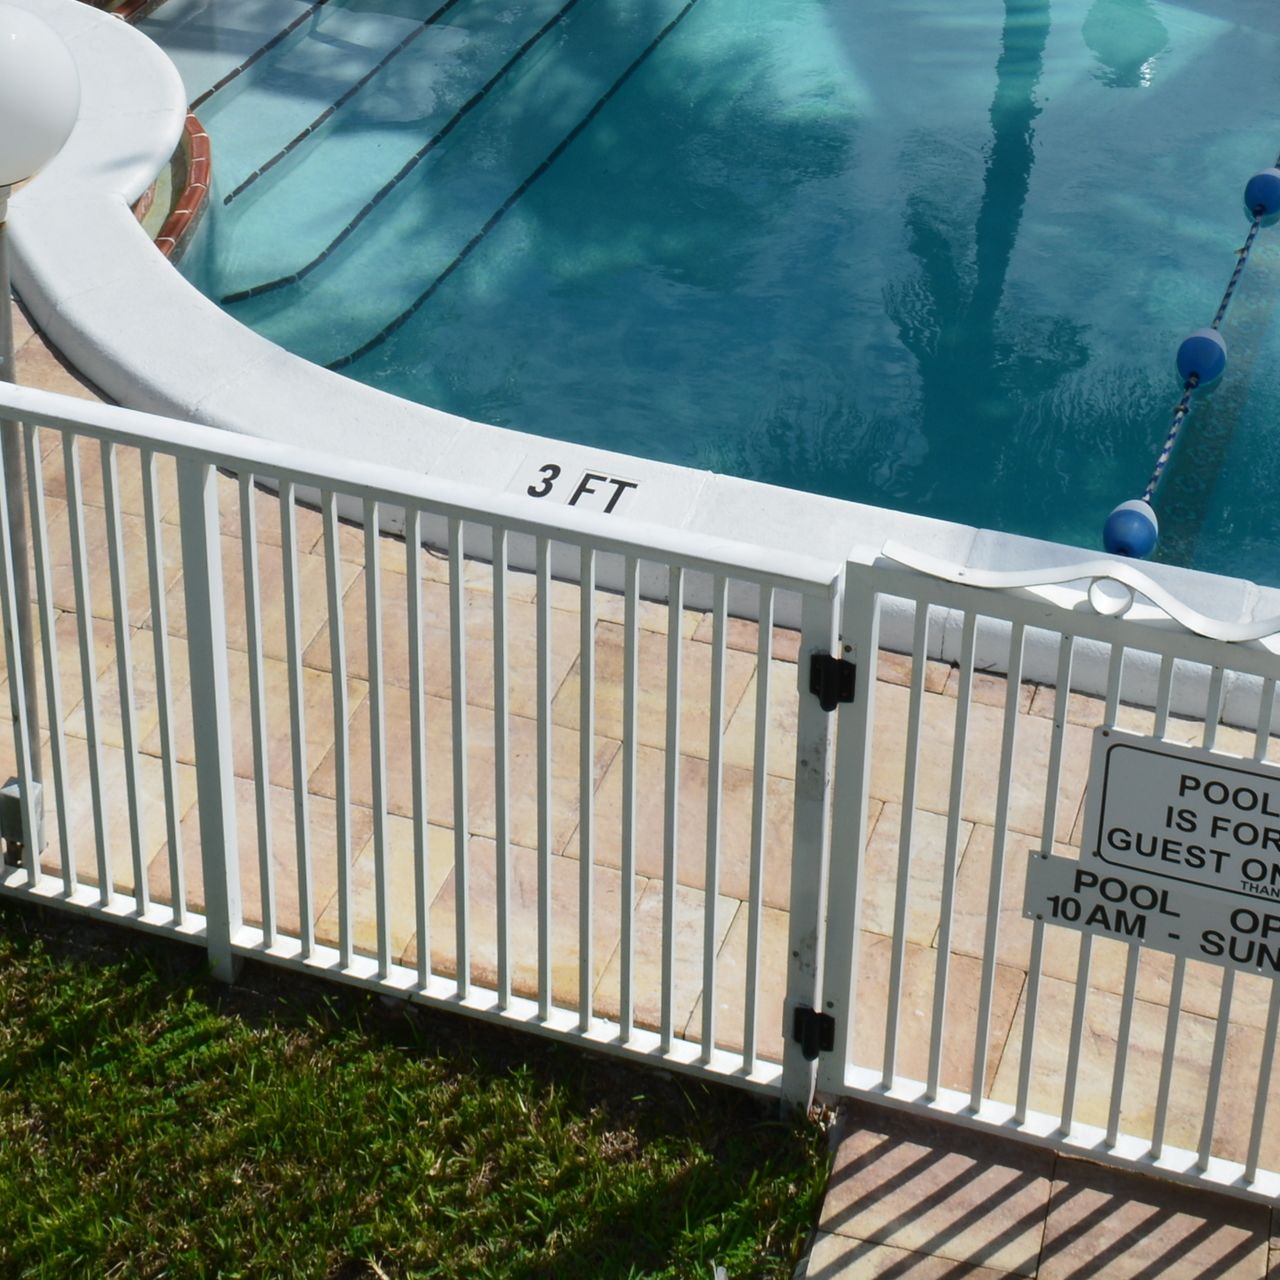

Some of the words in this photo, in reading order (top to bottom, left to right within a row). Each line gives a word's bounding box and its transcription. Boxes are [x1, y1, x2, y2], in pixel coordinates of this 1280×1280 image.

[527, 463, 562, 498] 3
[568, 473, 638, 514] FT
[1166, 805, 1197, 833] IS
[1179, 774, 1280, 817] POOL
[1107, 827, 1231, 874] GUEST
[1074, 869, 1180, 918] POOL
